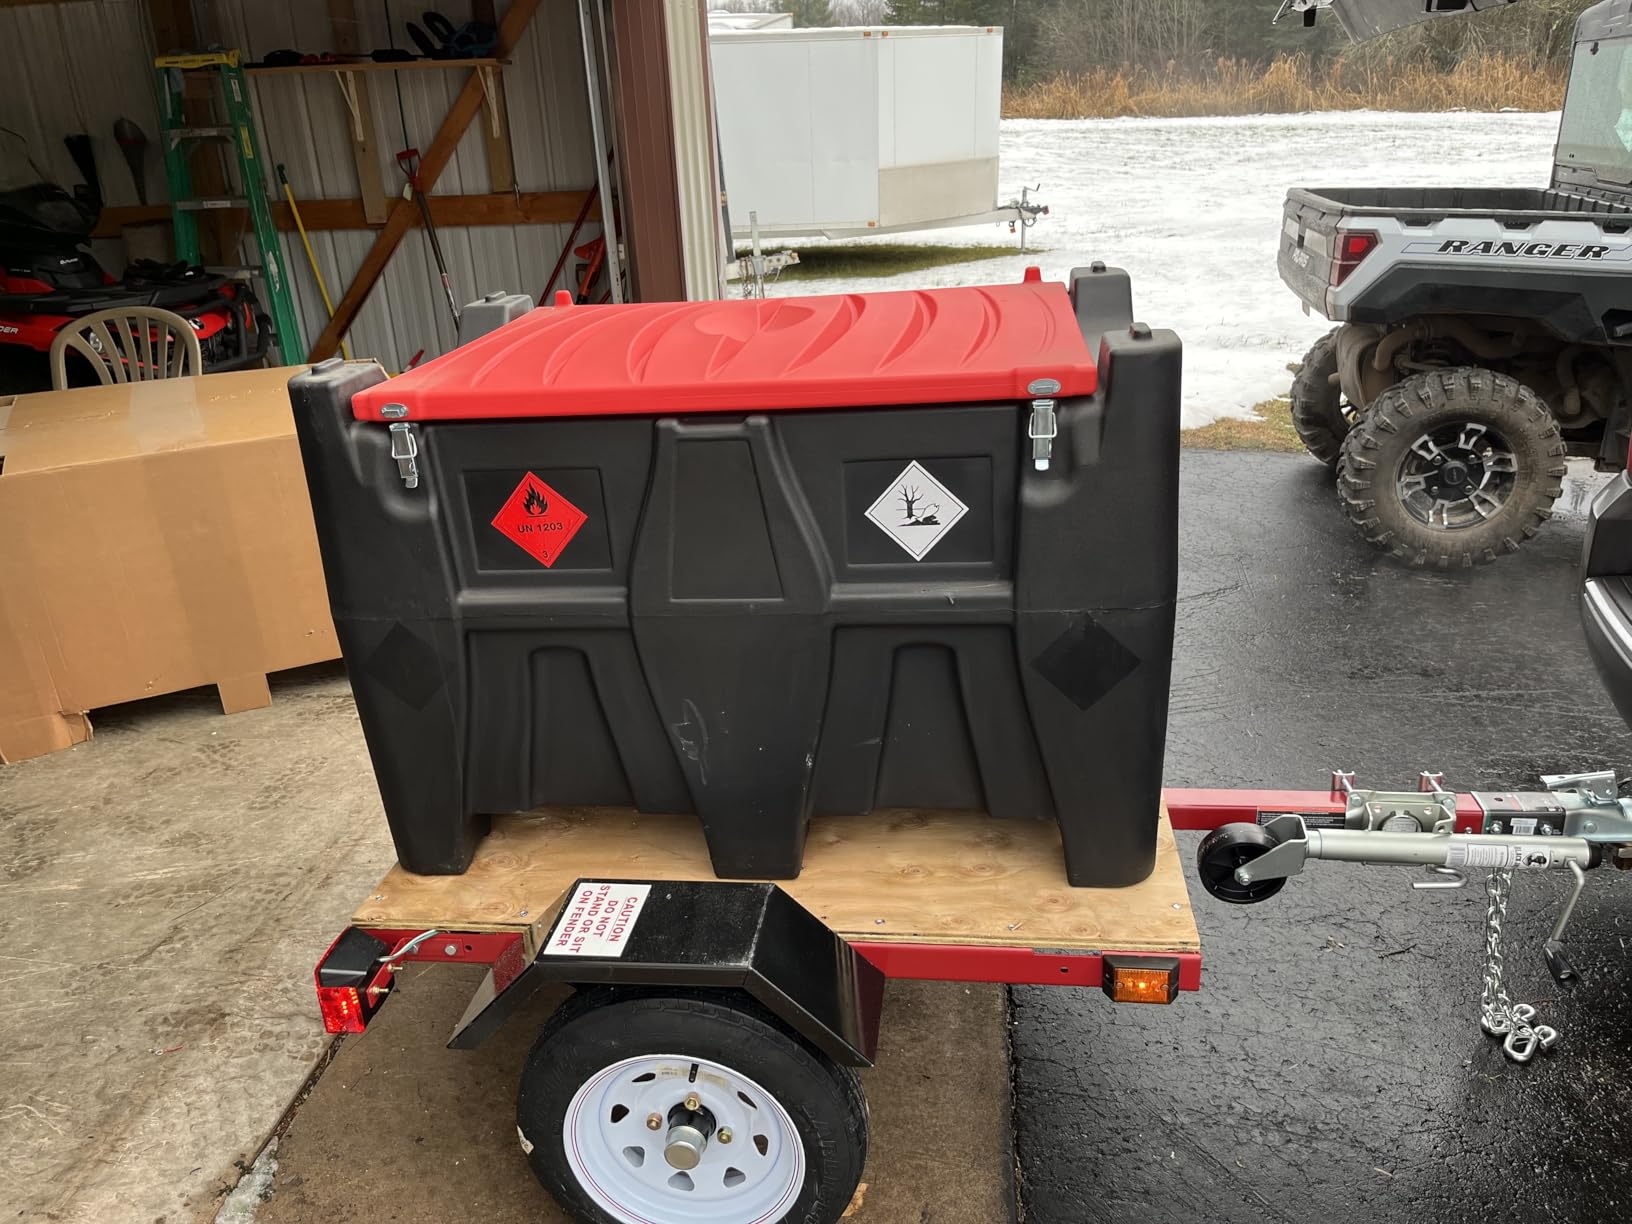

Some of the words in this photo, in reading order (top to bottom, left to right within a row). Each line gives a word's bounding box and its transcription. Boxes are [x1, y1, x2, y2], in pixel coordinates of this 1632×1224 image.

[1437, 240, 1609, 259] RANGER
[517, 525, 533, 533] UN
[537, 522, 564, 532] 1203
[543, 550, 549, 558] 3
[578, 890, 593, 904] ON
[587, 885, 611, 916] STAND
[604, 900, 618, 914] DO
[556, 907, 585, 946] FENDER
[579, 919, 593, 933] OR
[593, 916, 611, 937] NOT
[608, 896, 638, 942] CAUTION
[569, 936, 586, 953] SIT
